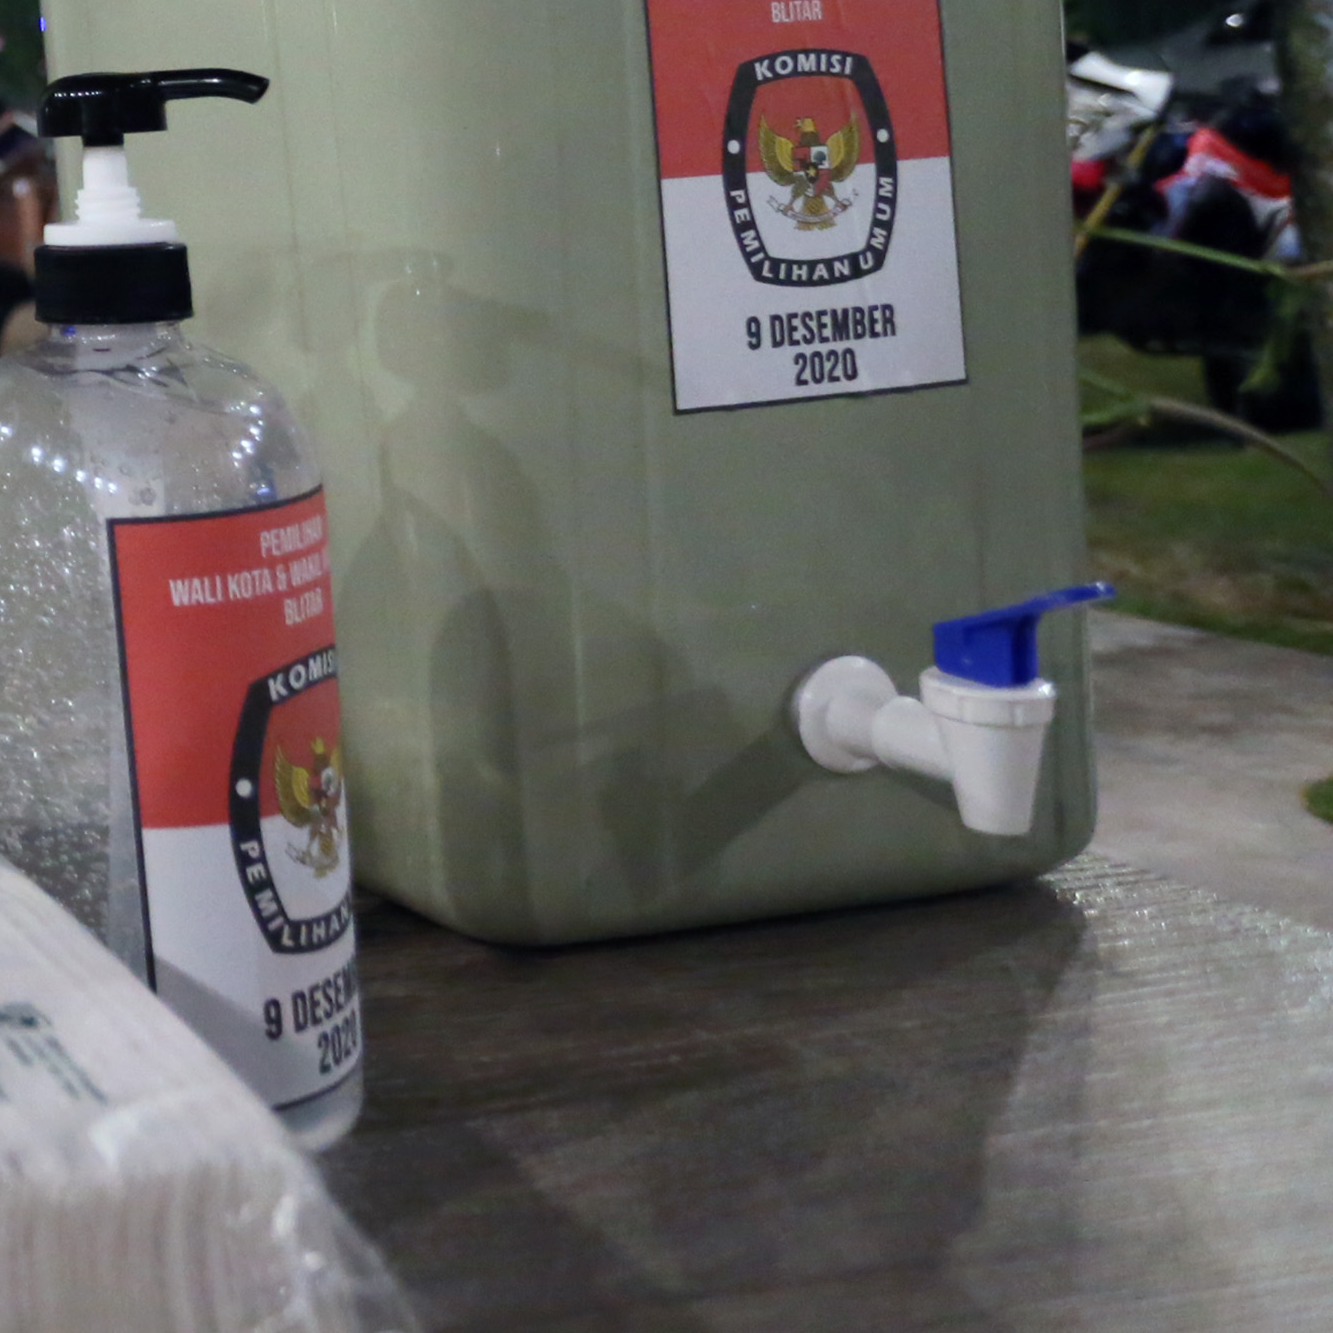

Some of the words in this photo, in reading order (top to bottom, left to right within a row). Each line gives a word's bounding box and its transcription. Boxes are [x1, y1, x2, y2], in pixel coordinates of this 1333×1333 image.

[770, 0, 823, 24] BLITAR
[754, 52, 854, 81] KOMISI
[729, 189, 851, 282] PEMILIHAN
[859, 176, 894, 270] UMUM
[745, 316, 761, 351] 9
[769, 303, 897, 349] DESEMBER
[793, 348, 859, 386] 2020
[169, 574, 223, 607] WALI
[227, 567, 273, 600] KOTA
[276, 563, 287, 591] &
[267, 648, 334, 703] KOMIS
[263, 998, 282, 1041] 9
